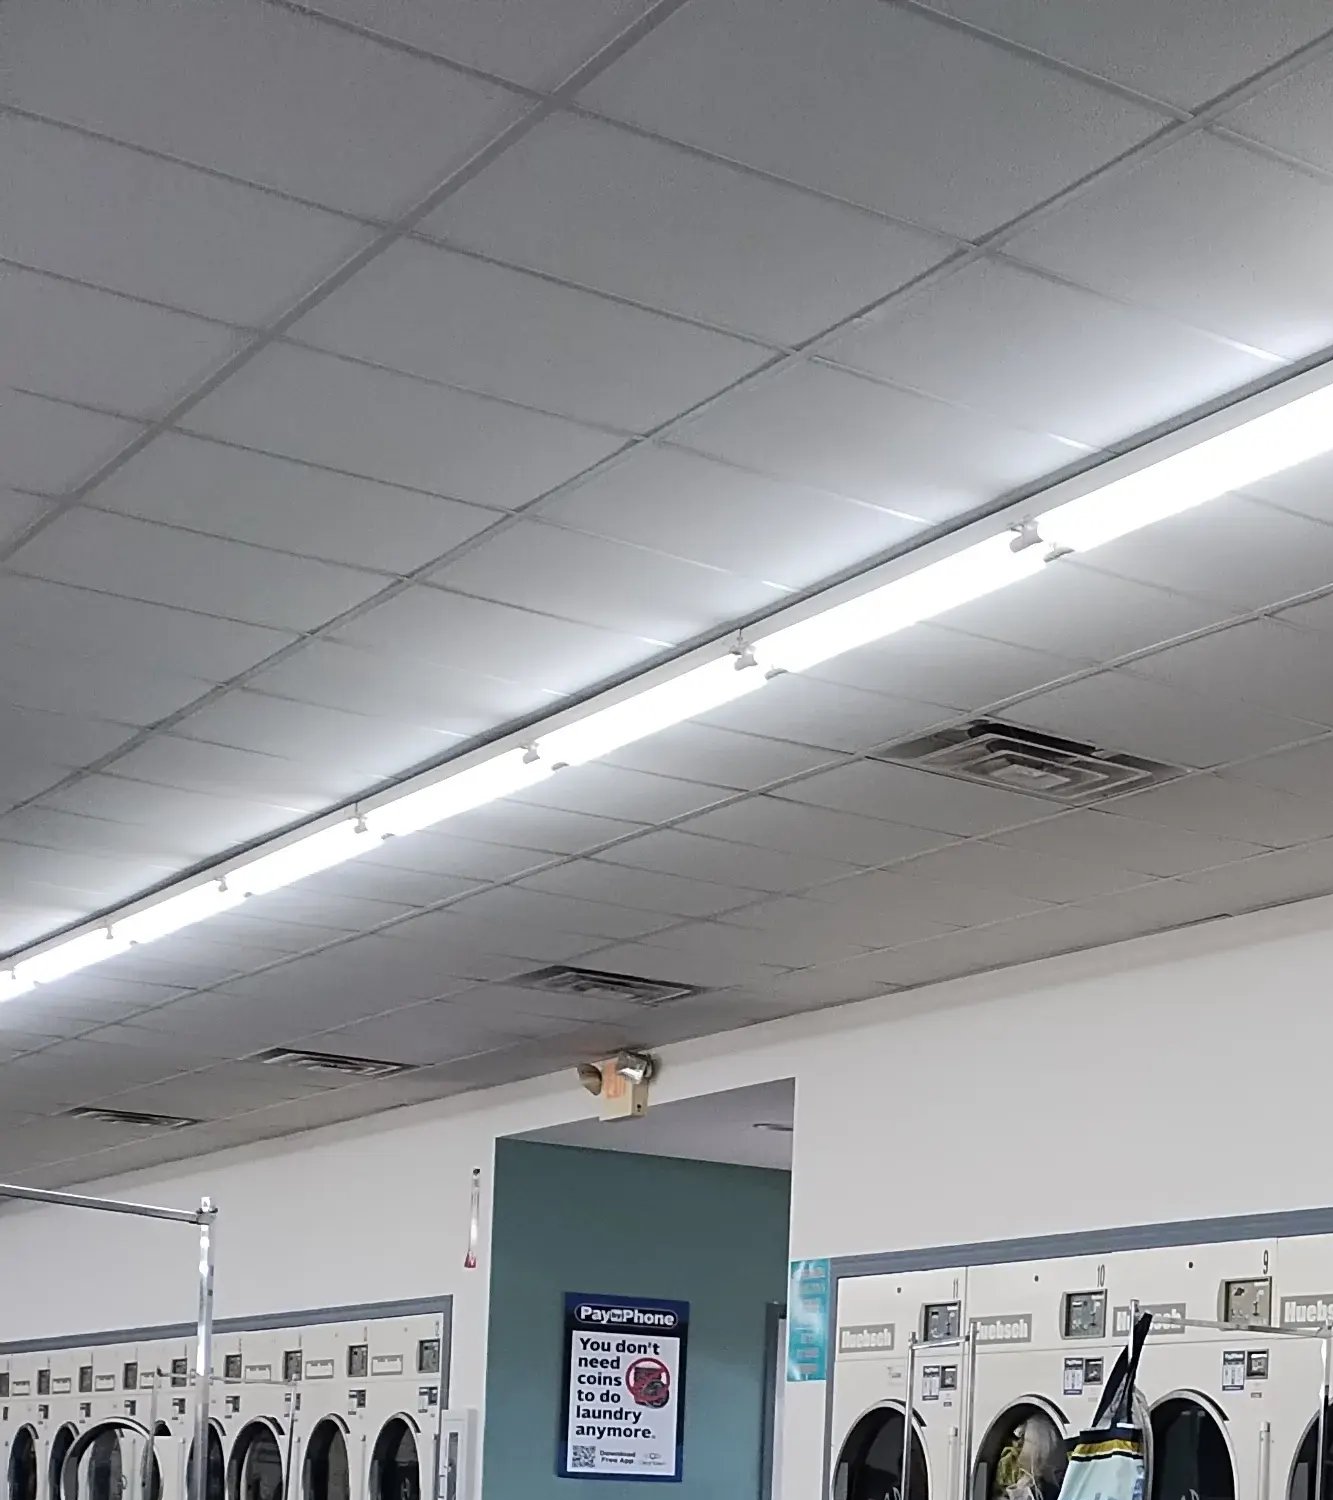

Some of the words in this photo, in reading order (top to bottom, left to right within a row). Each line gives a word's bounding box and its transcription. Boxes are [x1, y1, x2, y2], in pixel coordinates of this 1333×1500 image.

[1262, 1249, 1269, 1275] 9
[1097, 1263, 1106, 1288] 10
[579, 1337, 611, 1353] You
[615, 1339, 660, 1356] don't
[578, 1355, 621, 1370] need
[577, 1372, 622, 1387] coins
[577, 1389, 595, 1403] to
[599, 1390, 621, 1404] do
[576, 1405, 642, 1425] laundry
[575, 1425, 656, 1440] anymore.
